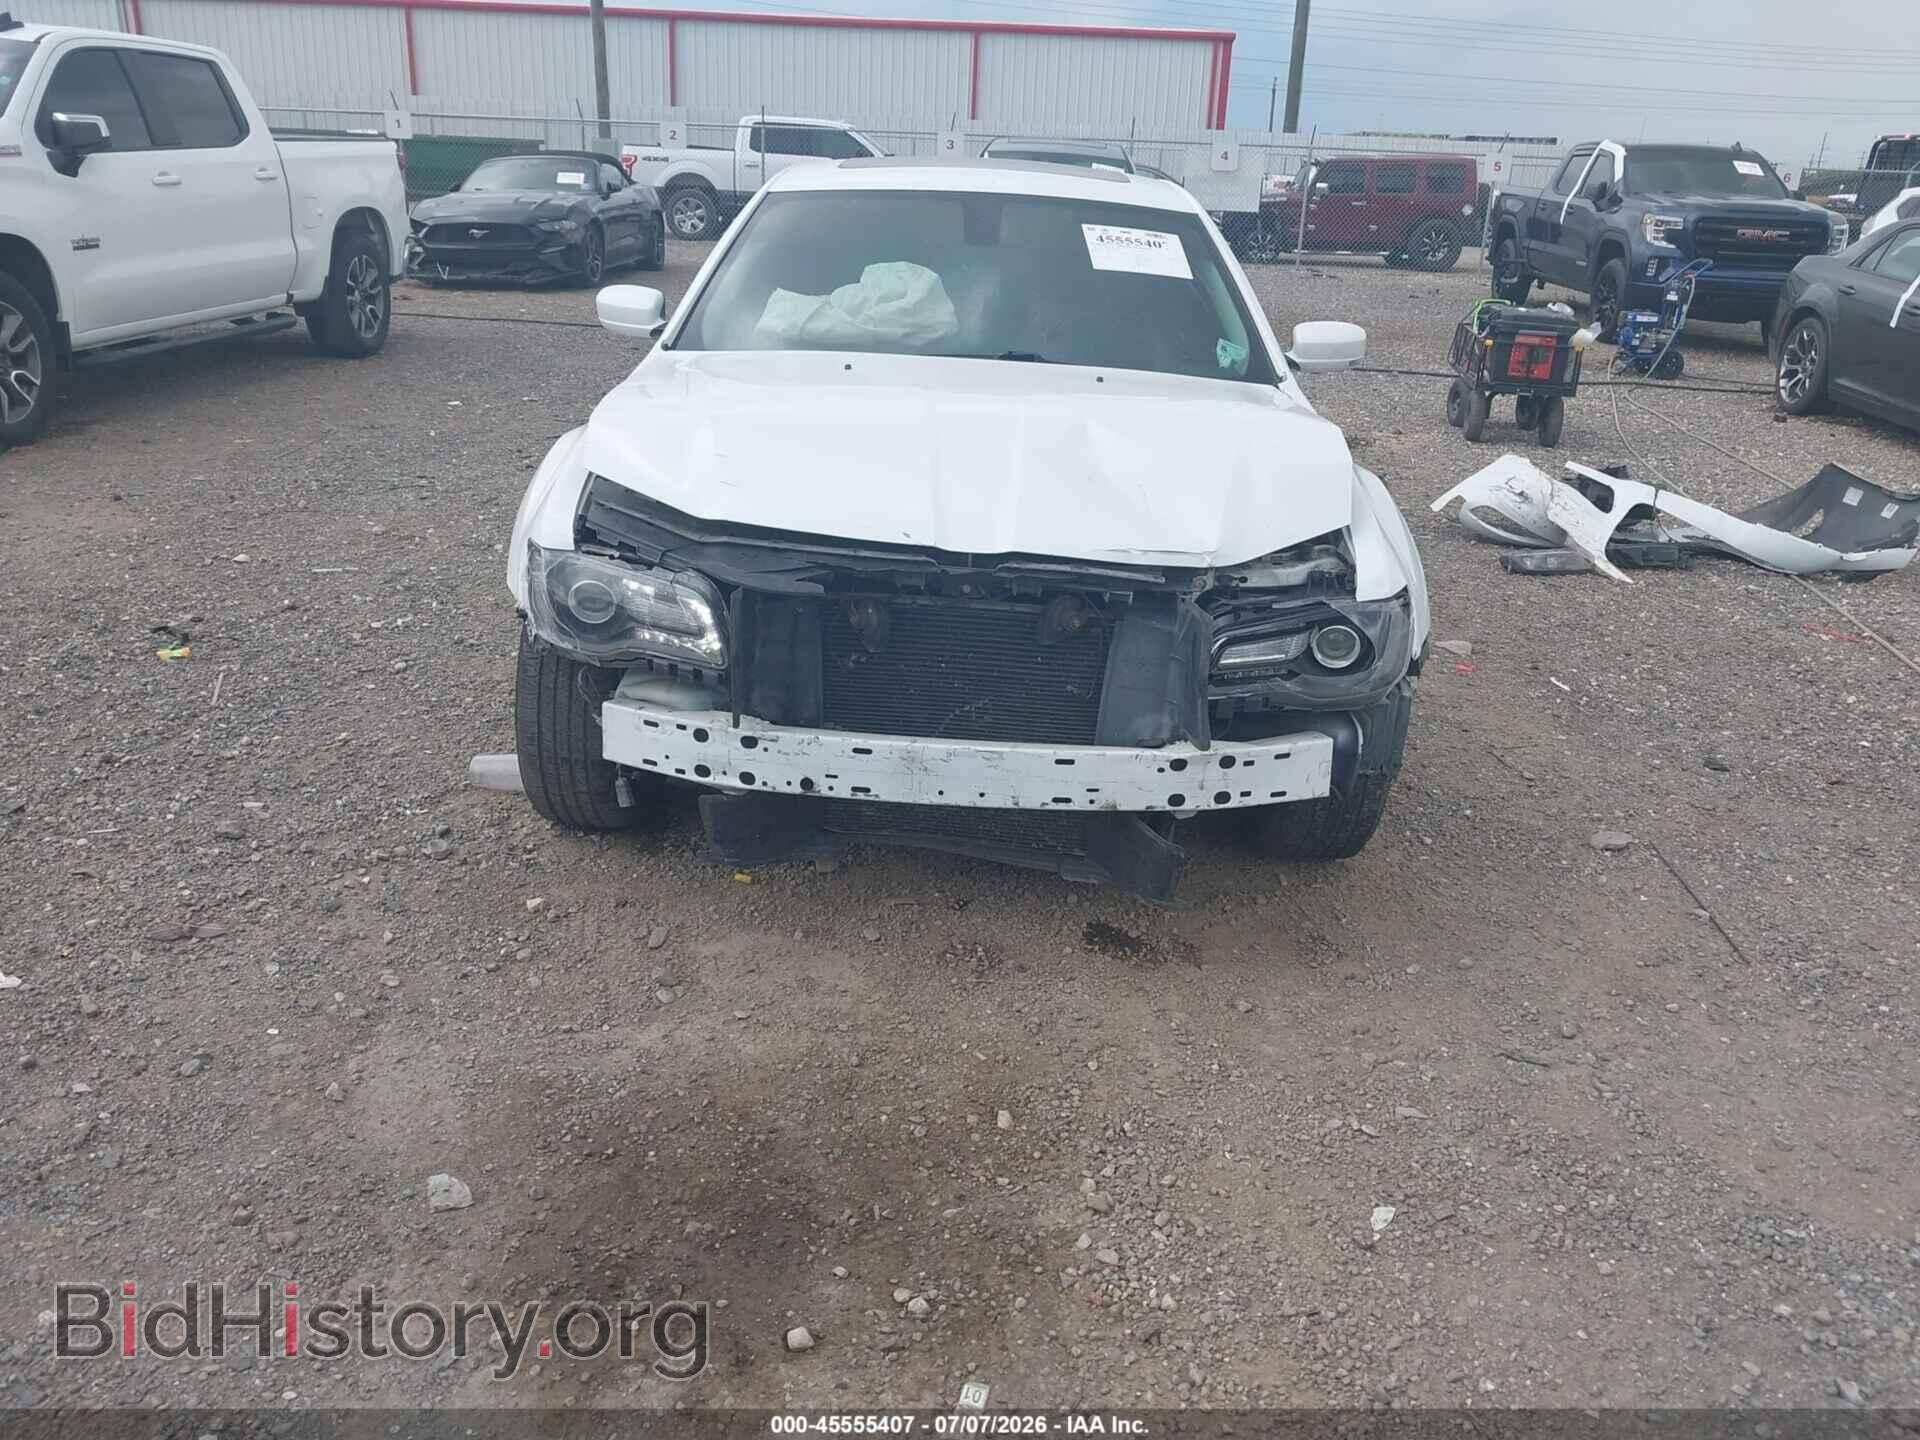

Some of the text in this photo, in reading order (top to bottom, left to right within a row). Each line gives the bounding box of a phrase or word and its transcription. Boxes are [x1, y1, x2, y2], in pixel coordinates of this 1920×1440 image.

[668, 129, 678, 141] 2
[945, 138, 955, 151] 3
[1219, 150, 1229, 161] 4
[1492, 161, 1503, 173] 5
[1782, 172, 1792, 184] 6
[1736, 228, 1791, 241] GMC
